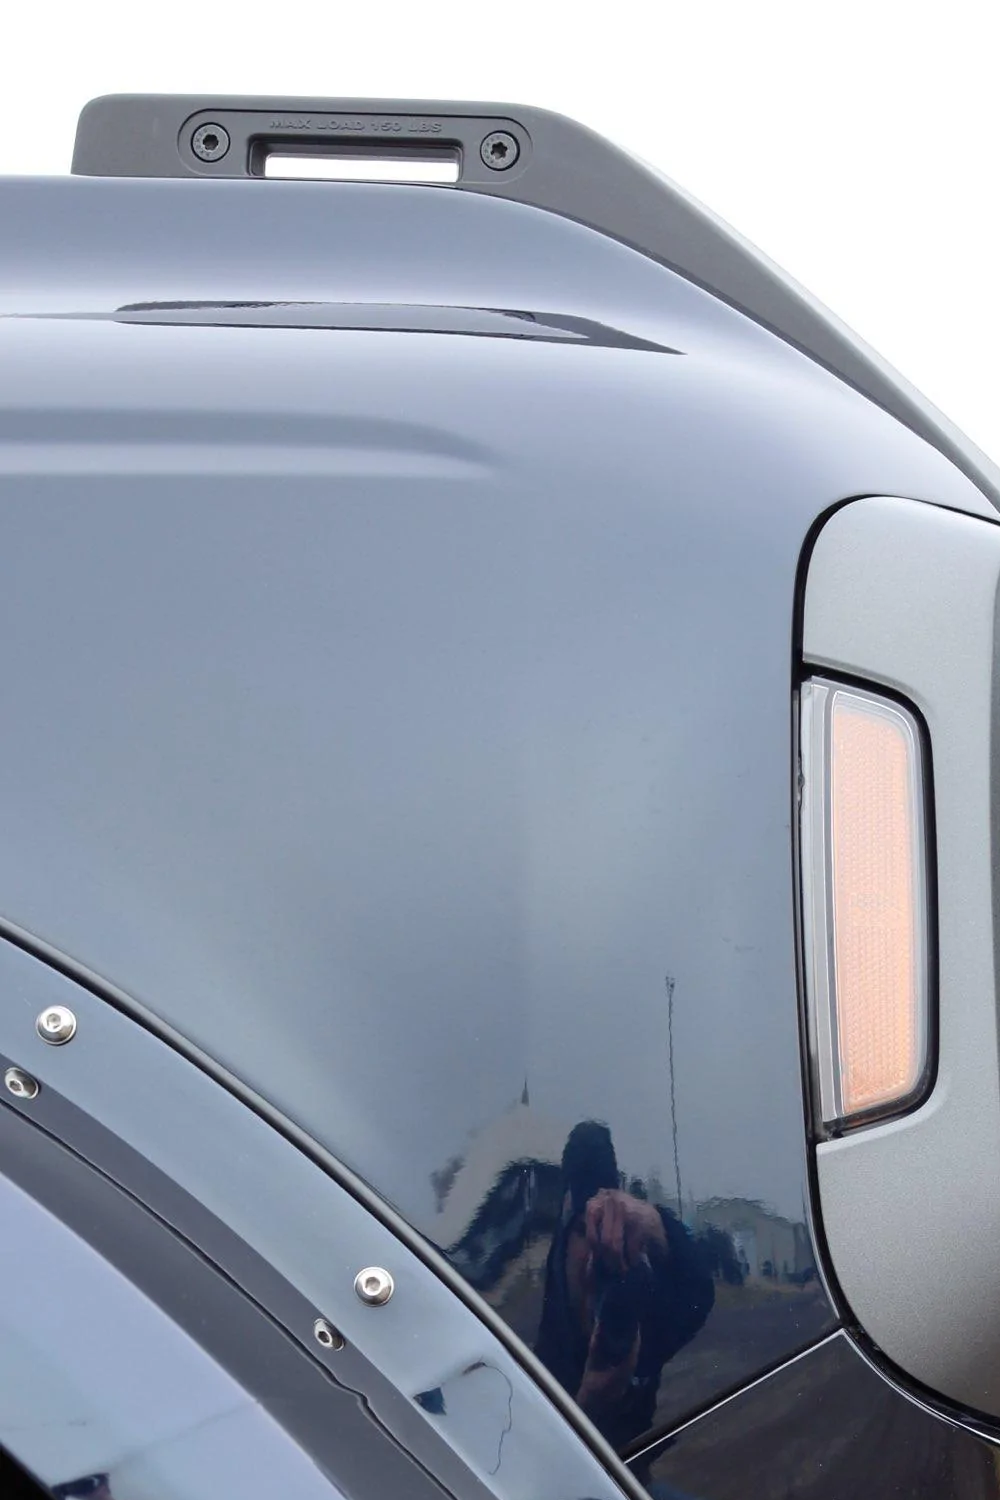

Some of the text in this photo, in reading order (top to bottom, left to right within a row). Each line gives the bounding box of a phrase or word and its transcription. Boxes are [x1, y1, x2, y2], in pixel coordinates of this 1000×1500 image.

[269, 119, 311, 130] MAX
[317, 120, 365, 131] LOAD
[408, 122, 442, 133] LBS
